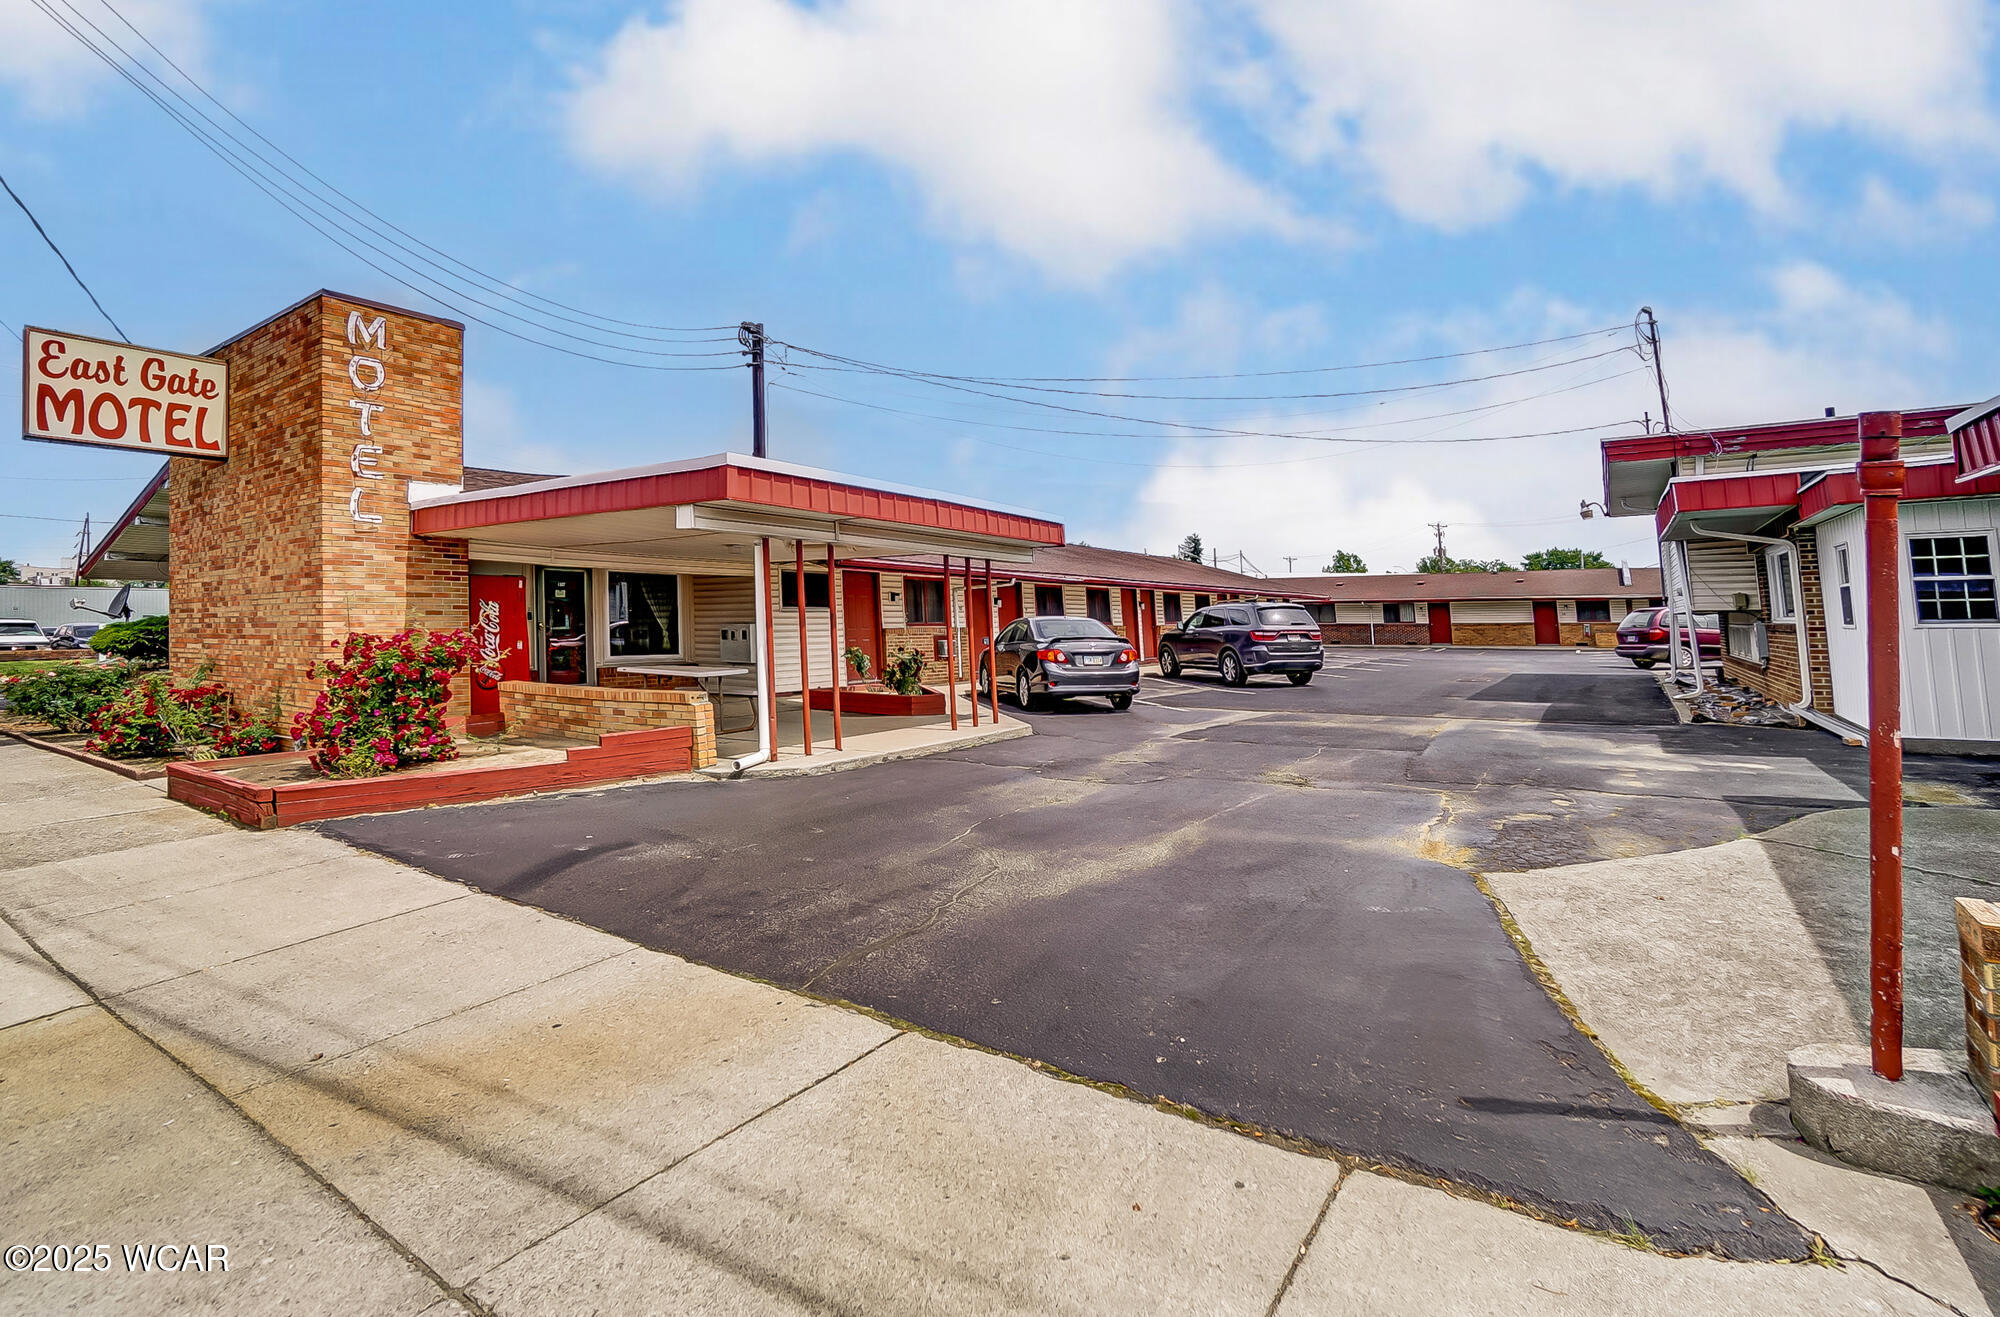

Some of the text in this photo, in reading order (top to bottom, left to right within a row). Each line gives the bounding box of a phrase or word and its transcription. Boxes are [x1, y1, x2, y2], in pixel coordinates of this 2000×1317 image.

[38, 340, 220, 400] East Gate
[36, 383, 221, 451] MOTEL
[347, 310, 387, 524] MOTEL
